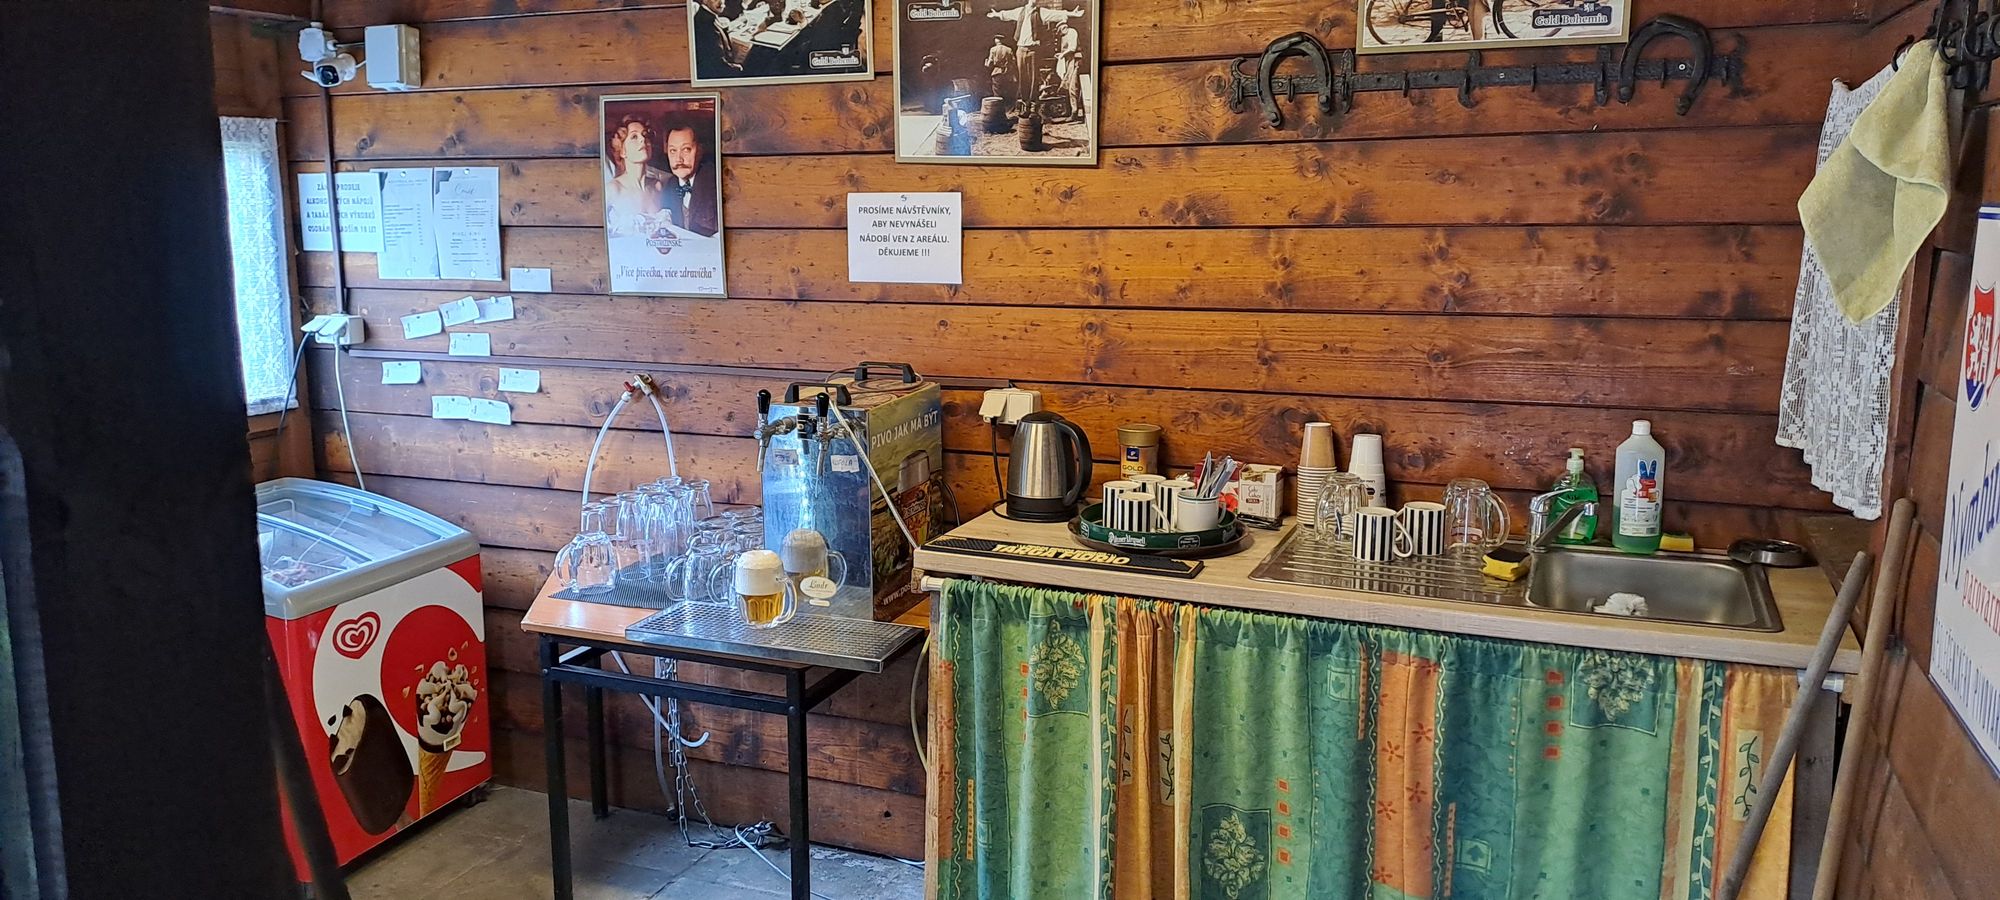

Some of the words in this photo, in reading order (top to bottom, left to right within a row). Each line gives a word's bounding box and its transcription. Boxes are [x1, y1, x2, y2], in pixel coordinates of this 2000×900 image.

[1535, 14, 1560, 26] Gold
[1561, 13, 1608, 25] Bohemia
[858, 205, 893, 214] PROSÍME
[896, 205, 951, 215] NÁVŠTĚVNÍKY,
[872, 220, 887, 228] ABY
[889, 219, 937, 228] NEVYNÁŠELI
[860, 233, 890, 242] NÁDOBÍ
[916, 234, 950, 243] AREÁLU.
[878, 247, 919, 256] DĚKUJEME
[921, 248, 930, 256] !!!
[871, 429, 892, 449] PIVO
[894, 421, 908, 440] JAK
[910, 412, 922, 433] MÁ
[924, 408, 938, 427] BÝT
[1122, 464, 1144, 472] GOLD
[992, 543, 1054, 558] TARGA
